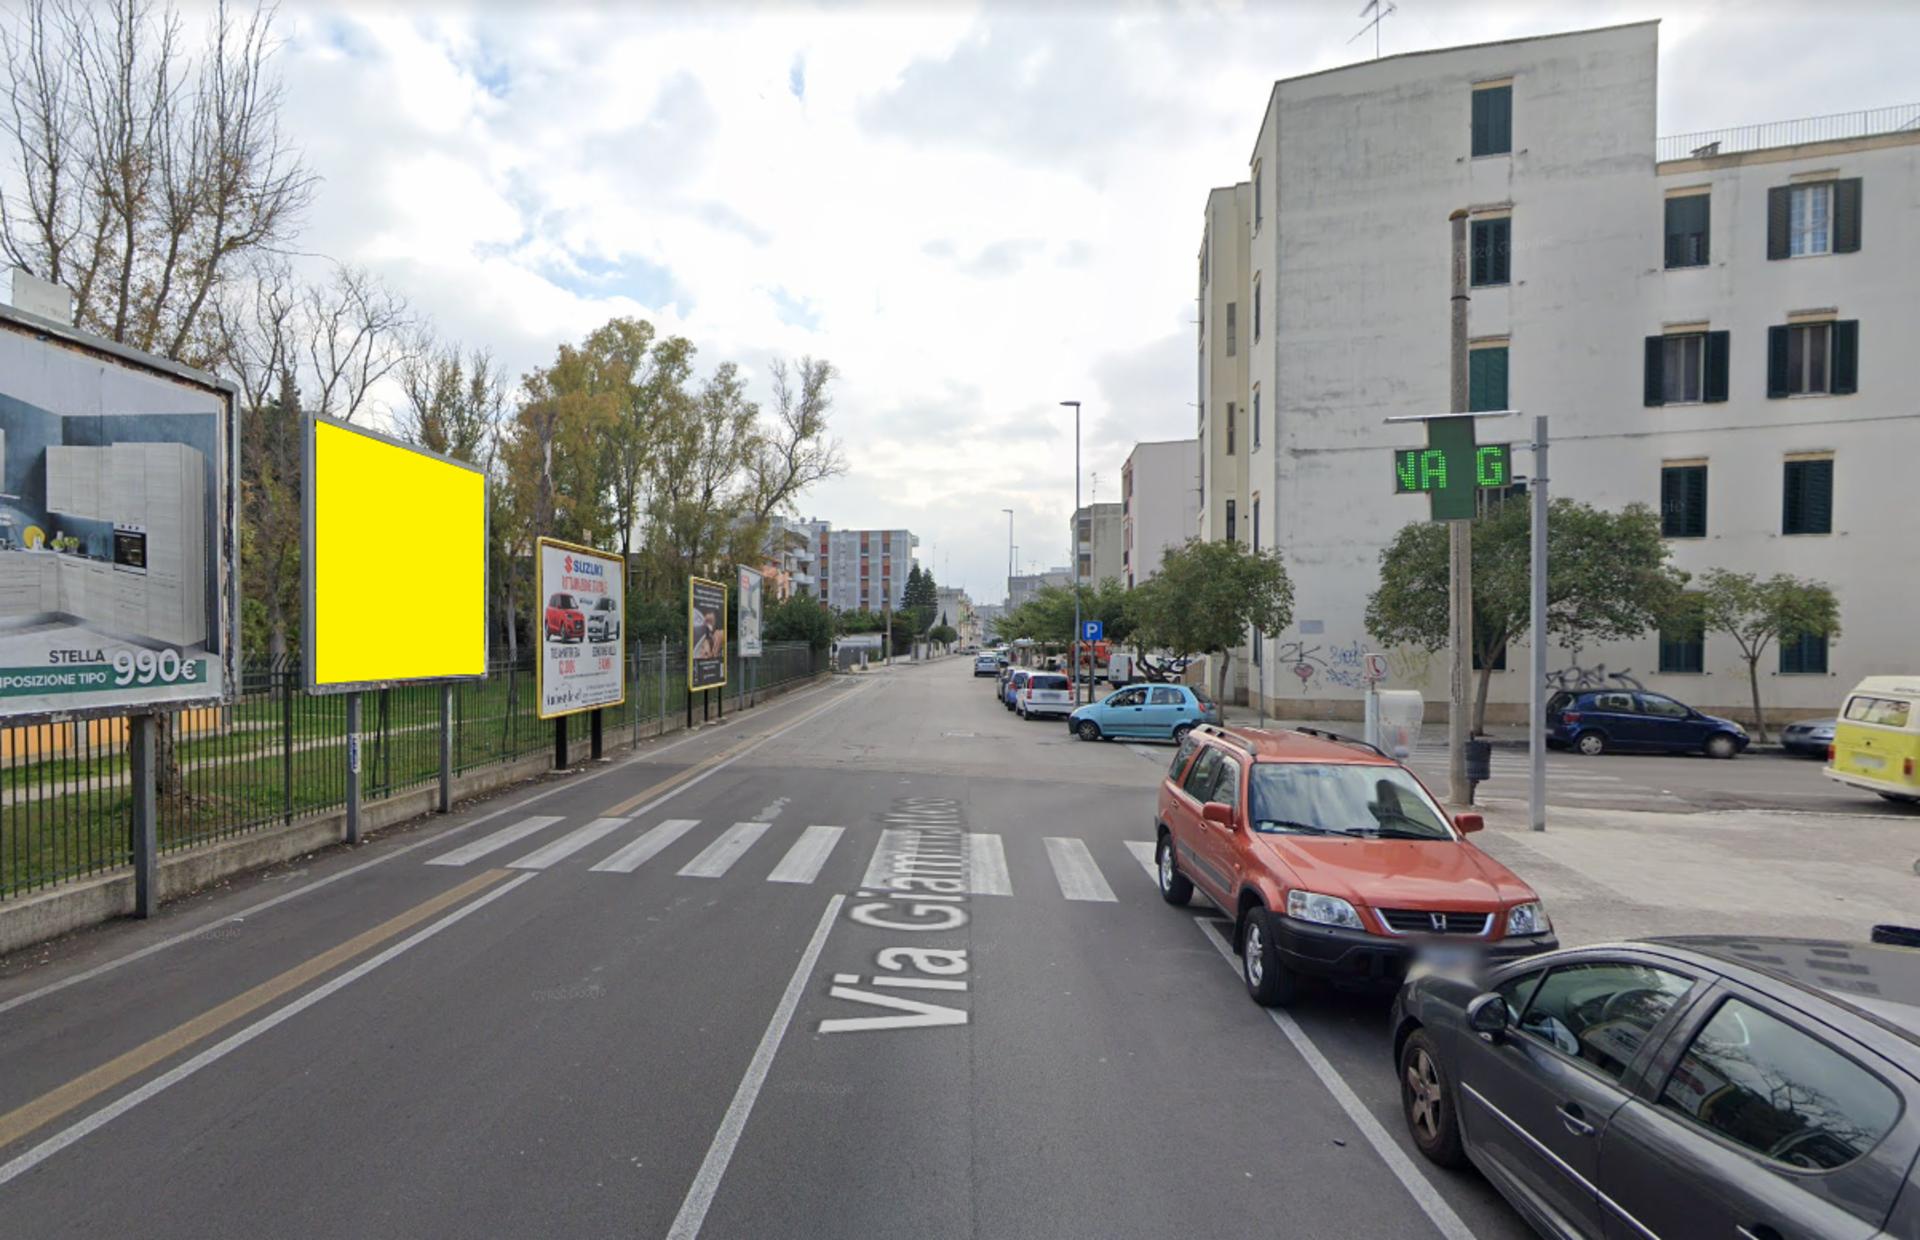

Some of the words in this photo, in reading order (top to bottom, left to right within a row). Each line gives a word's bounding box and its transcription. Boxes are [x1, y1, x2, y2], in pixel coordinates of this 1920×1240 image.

[1477, 446, 1502, 486] G
[573, 559, 604, 577] SUZUKI
[1086, 622, 1099, 639] P
[49, 649, 106, 664] STELLA
[112, 648, 198, 686] 990€
